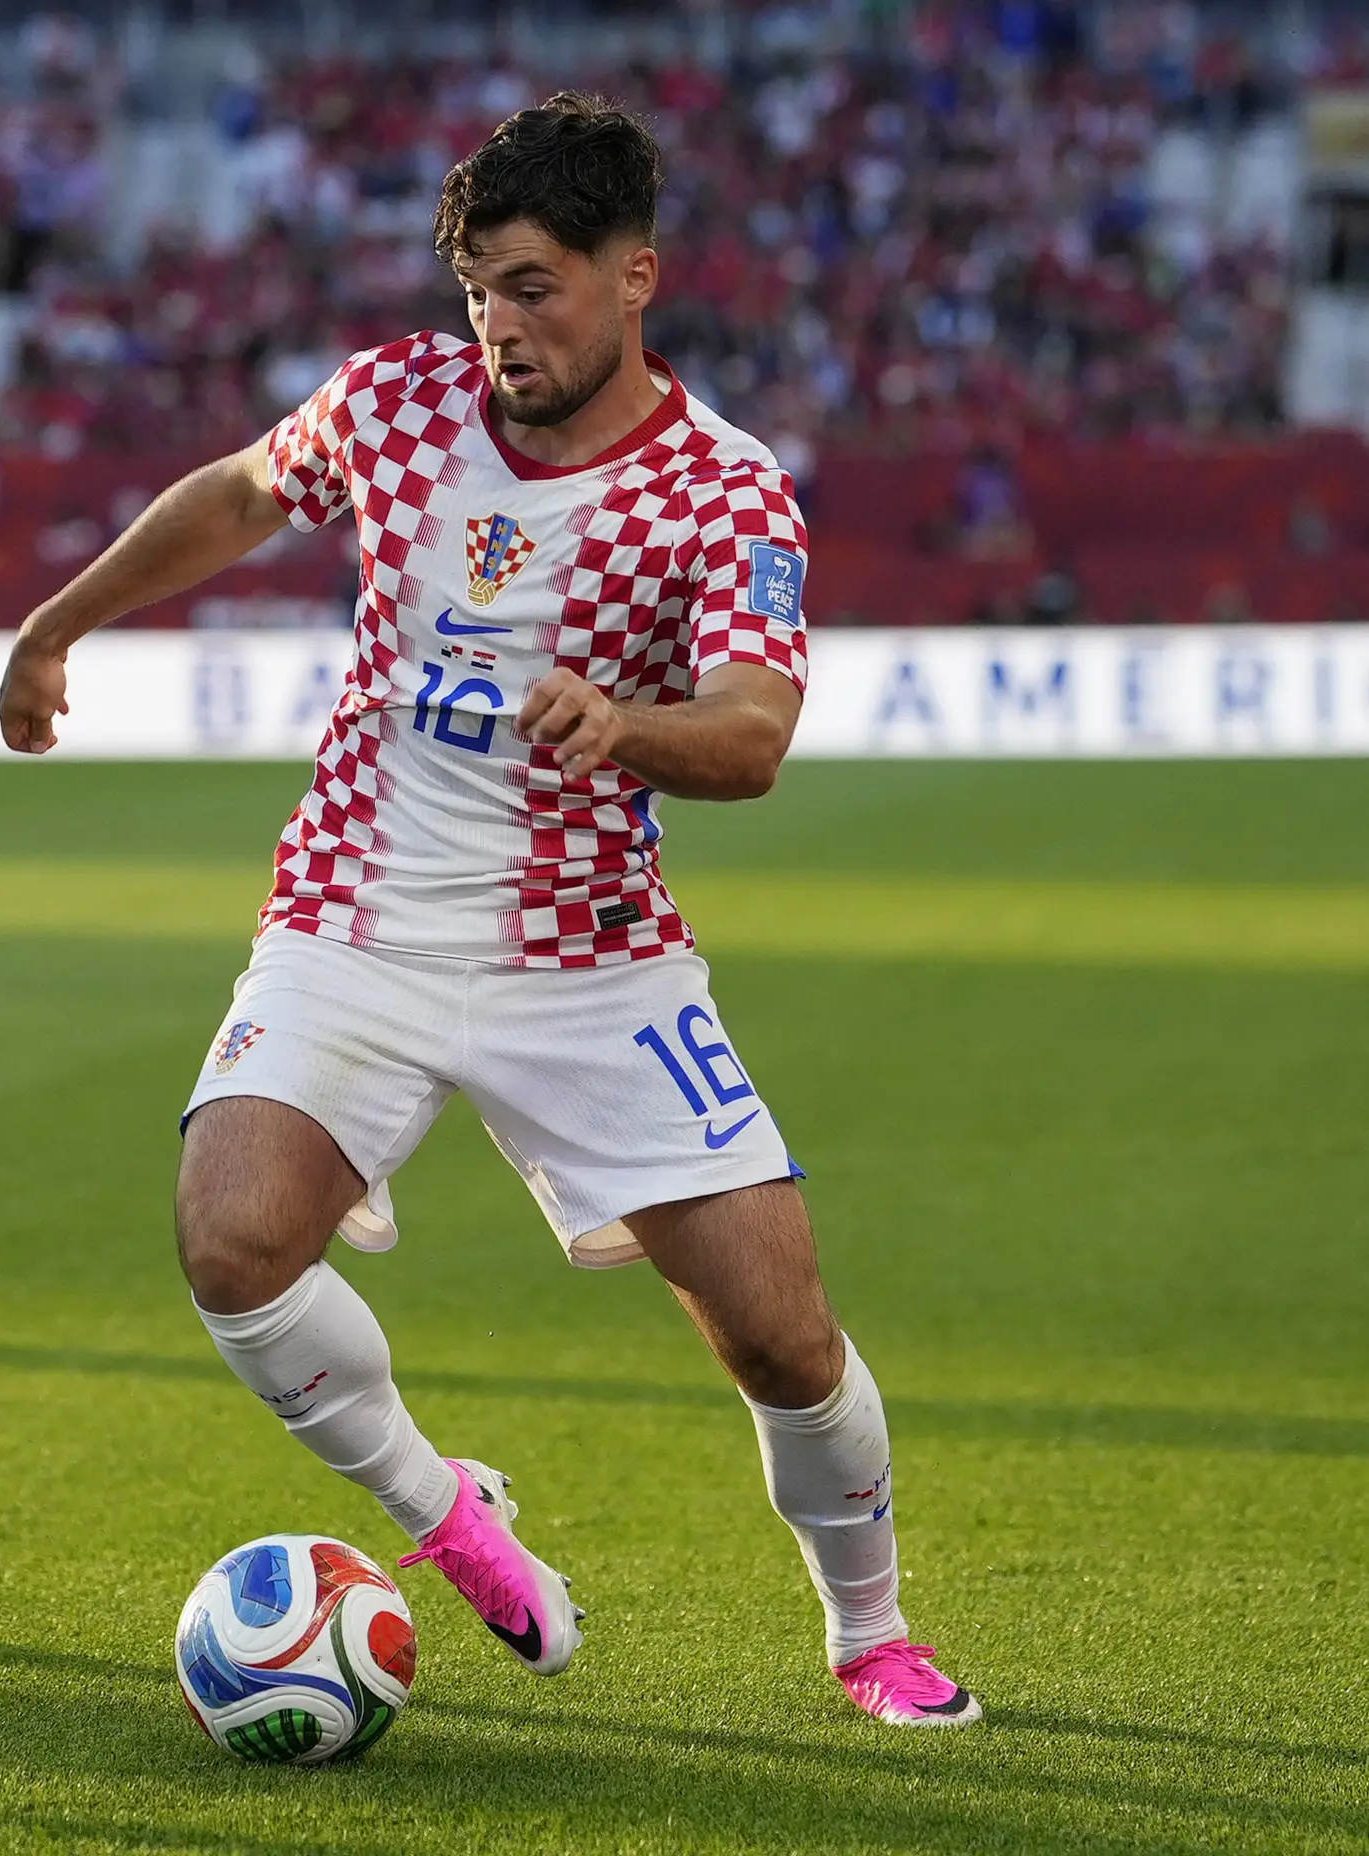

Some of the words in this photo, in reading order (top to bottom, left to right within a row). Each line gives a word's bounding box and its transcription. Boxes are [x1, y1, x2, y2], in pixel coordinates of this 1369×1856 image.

[768, 589, 794, 611] PEACE
[871, 650, 1369, 746] AMERI
[633, 1003, 753, 1117] 16
